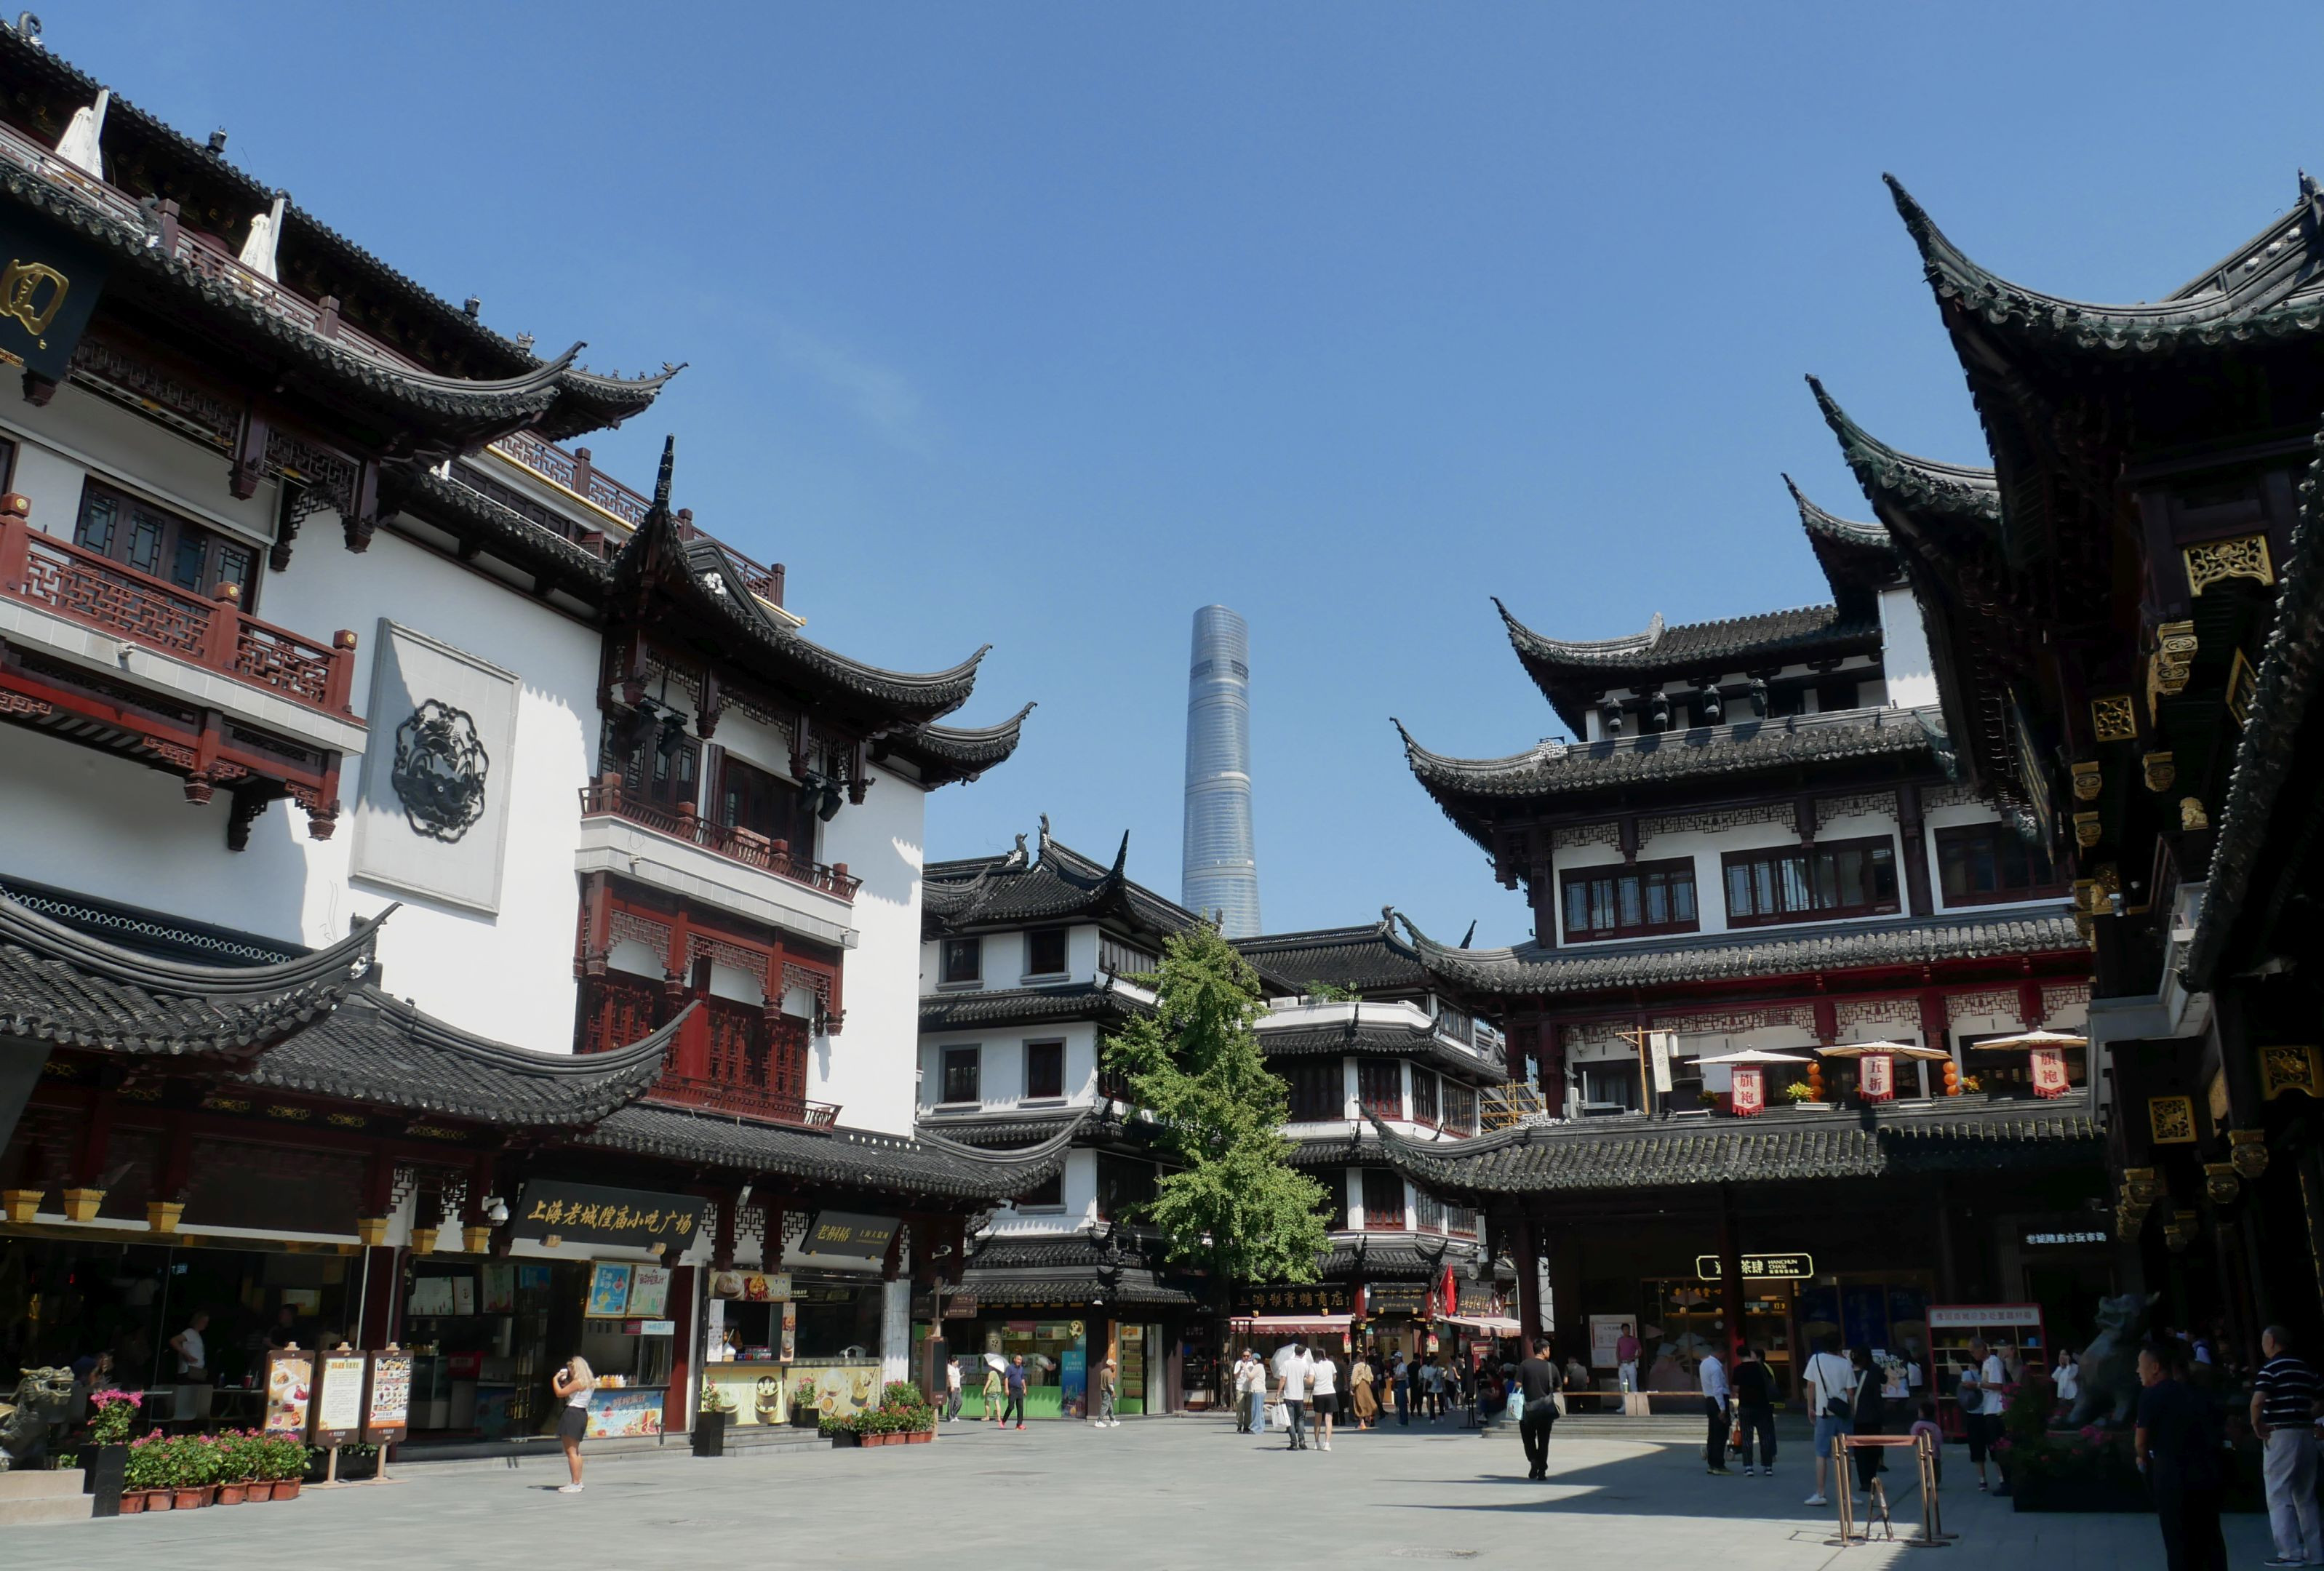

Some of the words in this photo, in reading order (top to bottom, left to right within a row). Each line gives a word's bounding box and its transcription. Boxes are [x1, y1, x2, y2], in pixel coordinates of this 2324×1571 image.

[1868, 1060, 1882, 1091] 五折
[2041, 1052, 2058, 1083] 旗袍
[1739, 1074, 1754, 1103] 旗袍
[527, 1199, 692, 1235] 上海老城隍庙小吃广场
[2025, 1232, 2107, 1244] 老城隍庙古玩市场
[1239, 1290, 1344, 1308] 上海梨膏糖商店
